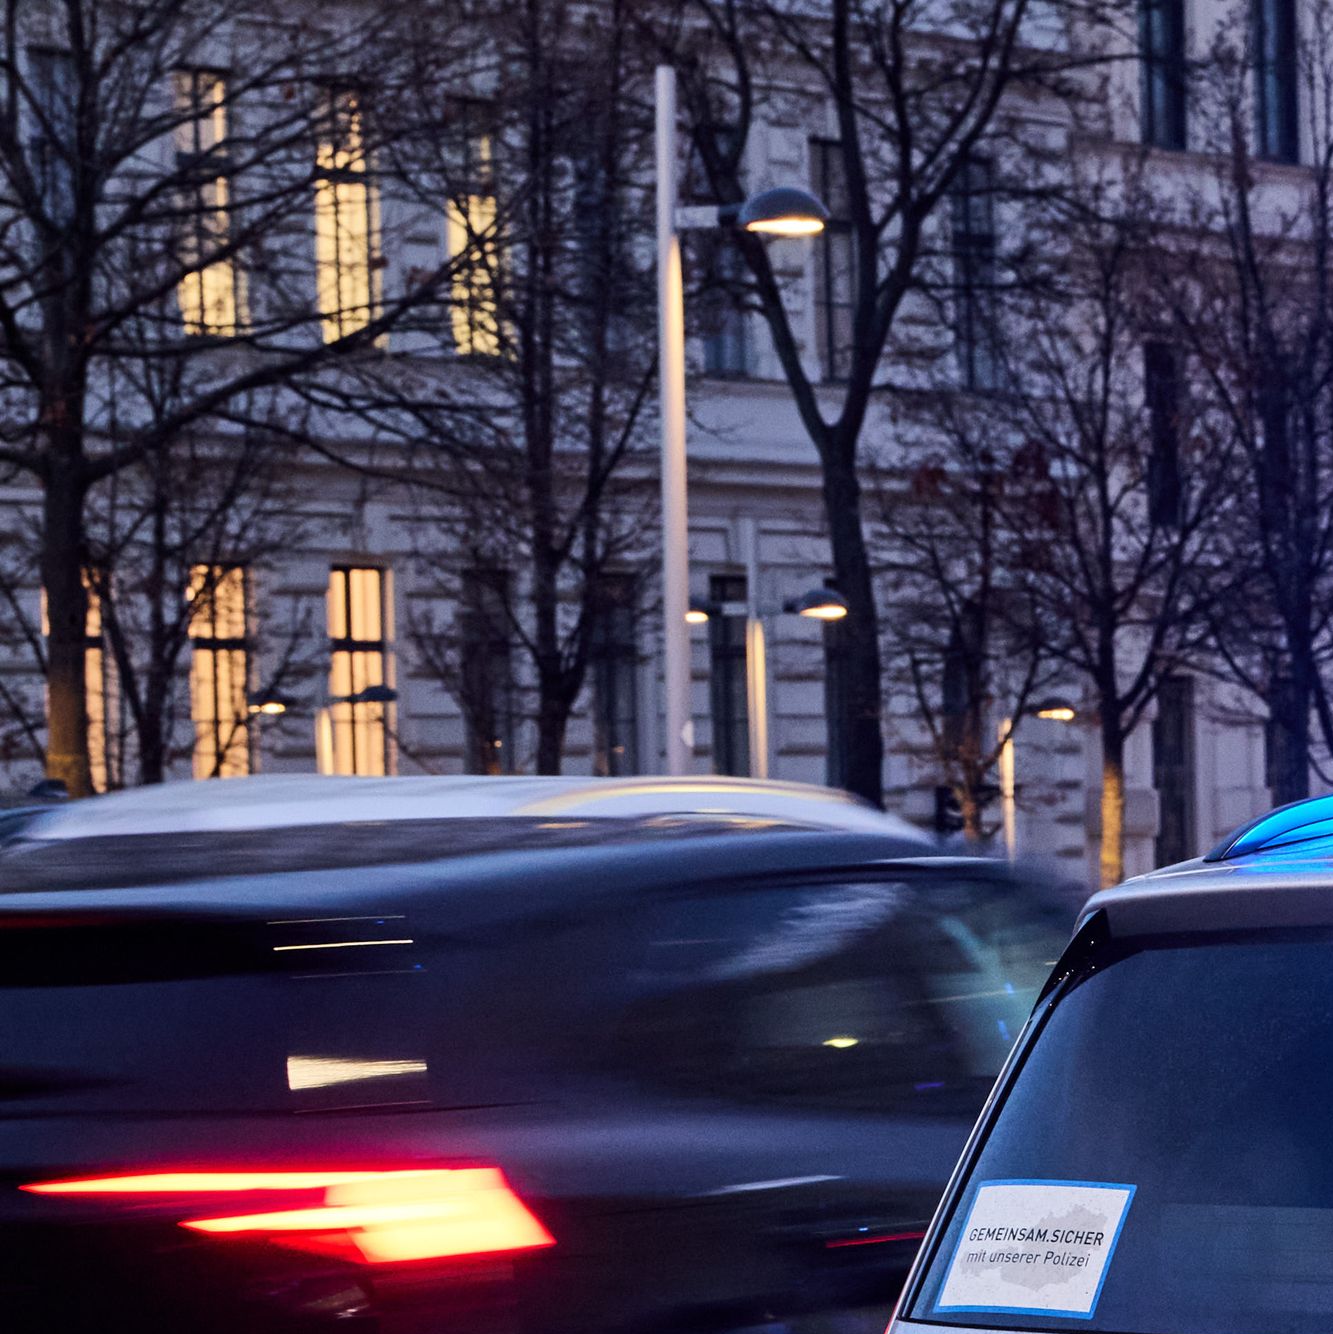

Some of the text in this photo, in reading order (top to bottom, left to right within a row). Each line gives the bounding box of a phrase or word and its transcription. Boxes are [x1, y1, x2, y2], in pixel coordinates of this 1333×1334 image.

[969, 1228, 1104, 1246] GEMEINSAM.SICHER
[967, 1249, 1090, 1267] mit unserer Polizei
